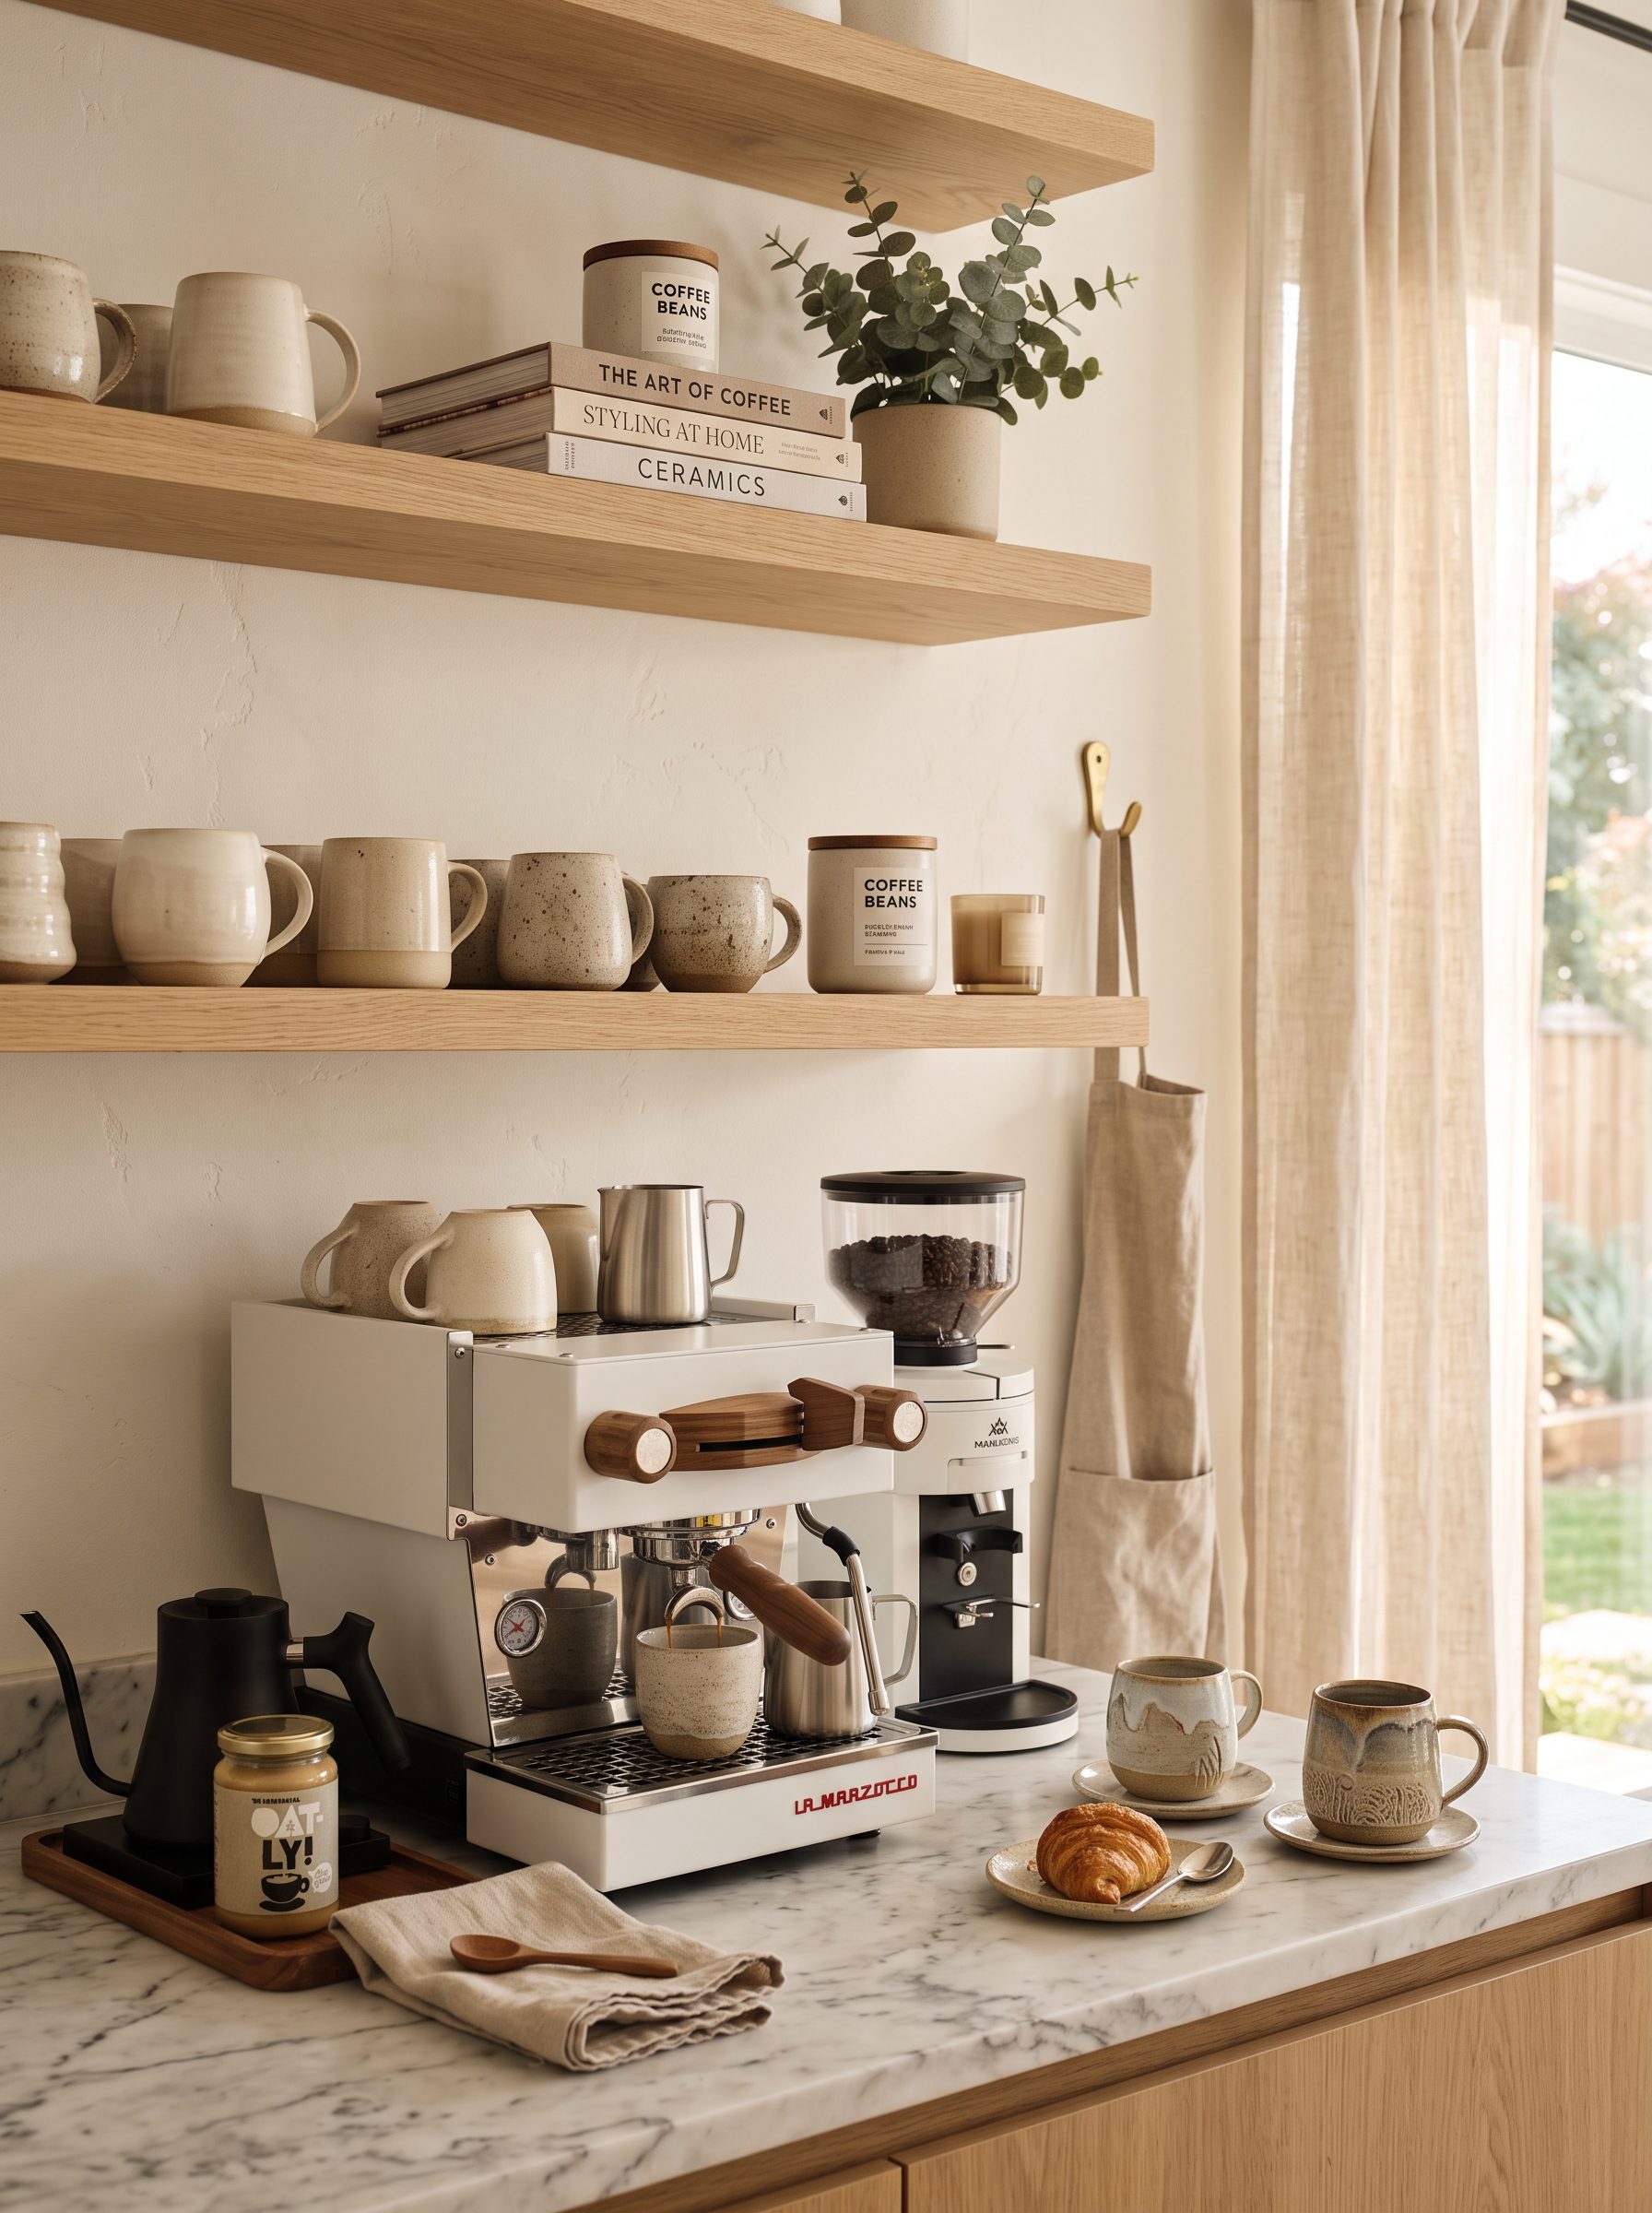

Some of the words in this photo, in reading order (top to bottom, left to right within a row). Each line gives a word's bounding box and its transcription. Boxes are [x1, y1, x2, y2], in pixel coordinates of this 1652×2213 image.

[652, 282, 710, 304] COFFEE
[657, 301, 707, 320] BEANS
[599, 364, 638, 387] THE
[644, 373, 681, 395] ART
[689, 382, 714, 400] OF
[721, 387, 791, 416] COFFEE
[584, 405, 671, 438] STYLING
[676, 422, 701, 443] AT
[706, 428, 764, 455] HOME
[638, 458, 765, 496] CERAMICS
[865, 879, 923, 892] COFFEE
[865, 895, 916, 908] BEANS
[263, 1836, 313, 1870] LY!
